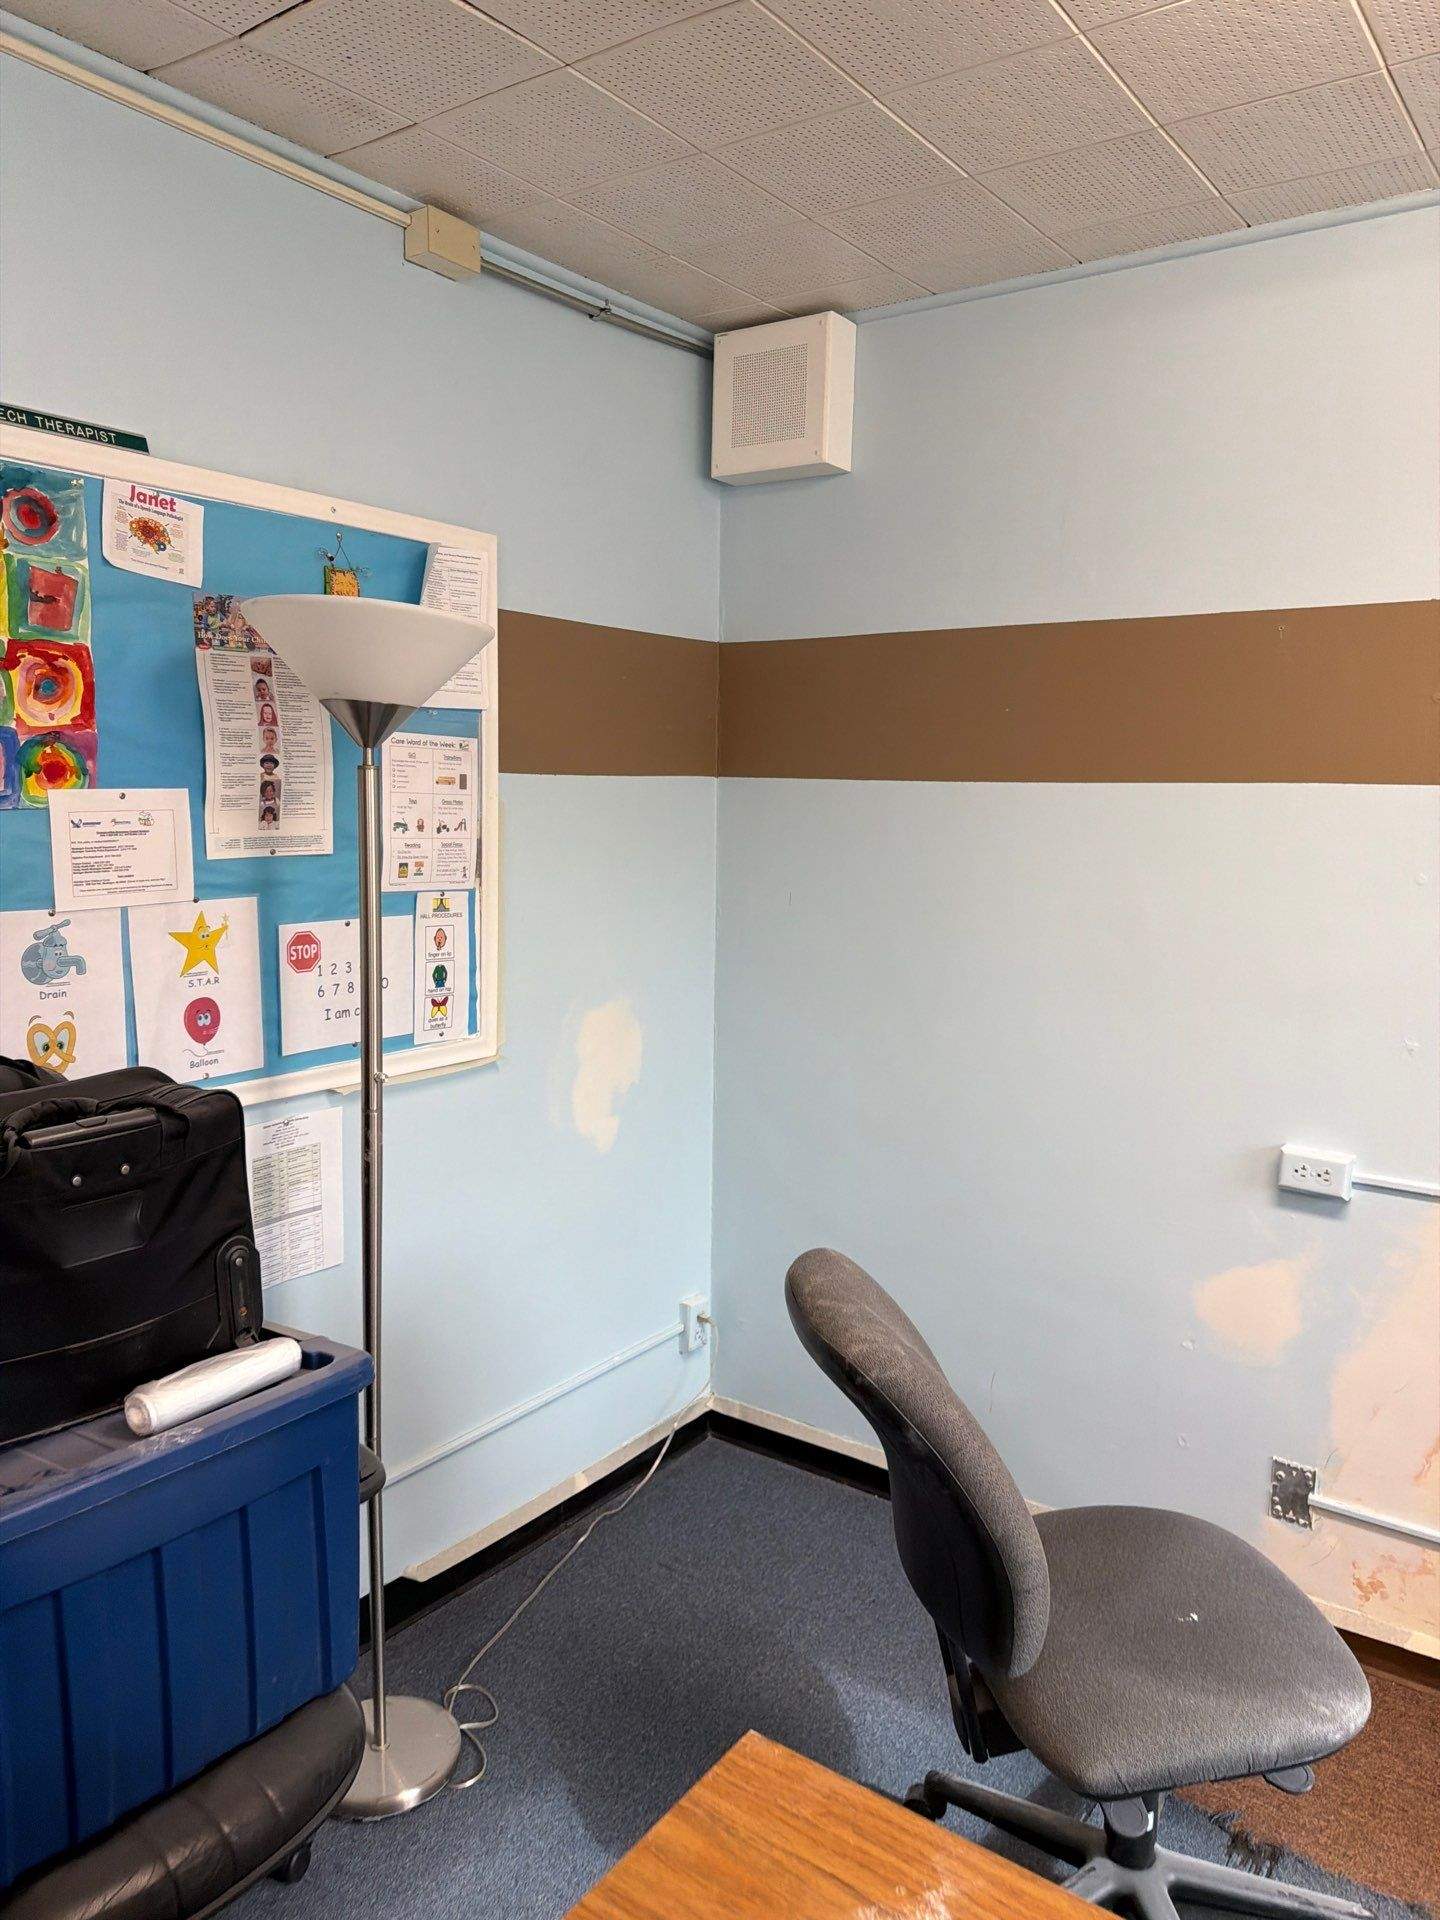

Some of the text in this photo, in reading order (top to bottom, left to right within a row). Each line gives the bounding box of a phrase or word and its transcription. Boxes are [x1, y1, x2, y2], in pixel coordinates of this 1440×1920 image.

[35, 416, 116, 444] THERAPIST
[129, 484, 177, 512] Janet
[407, 738, 421, 746] Word
[422, 739, 429, 747] of
[429, 740, 438, 748] the
[290, 944, 318, 961] STOP
[317, 961, 352, 977] 1 2 3
[39, 989, 67, 1000] Drain
[317, 985, 325, 998] 6
[332, 983, 340, 996] 7
[347, 981, 355, 994] 8
[324, 1008, 331, 1021] I
[334, 1007, 351, 1019] am
[189, 1057, 219, 1069] Balloon
